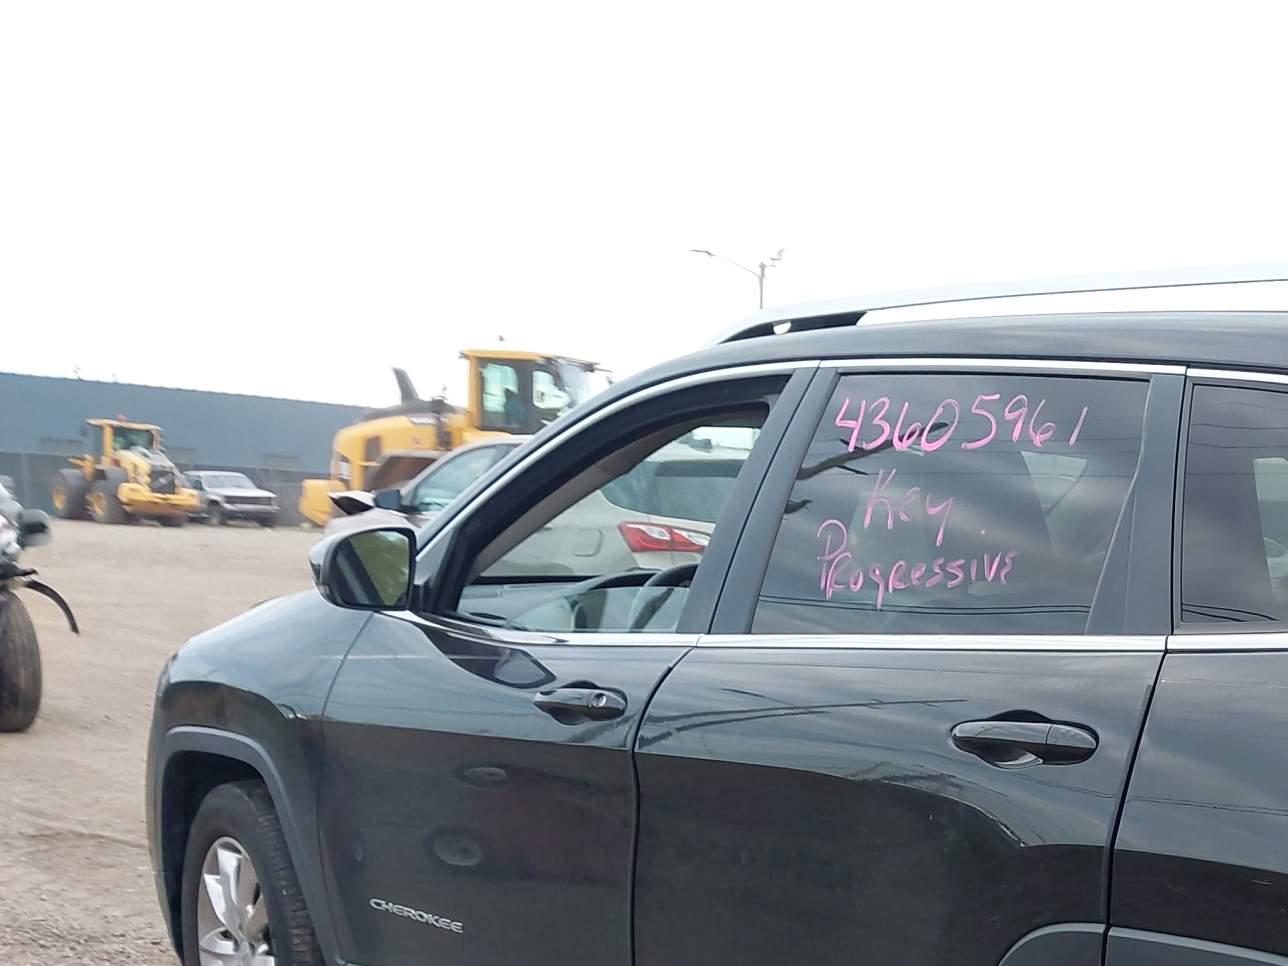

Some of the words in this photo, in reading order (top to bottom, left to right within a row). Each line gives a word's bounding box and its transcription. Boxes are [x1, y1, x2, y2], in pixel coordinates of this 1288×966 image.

[834, 392, 1089, 452] 43605961
[863, 467, 954, 547] Key
[368, 898, 464, 934] CHEROKEE
